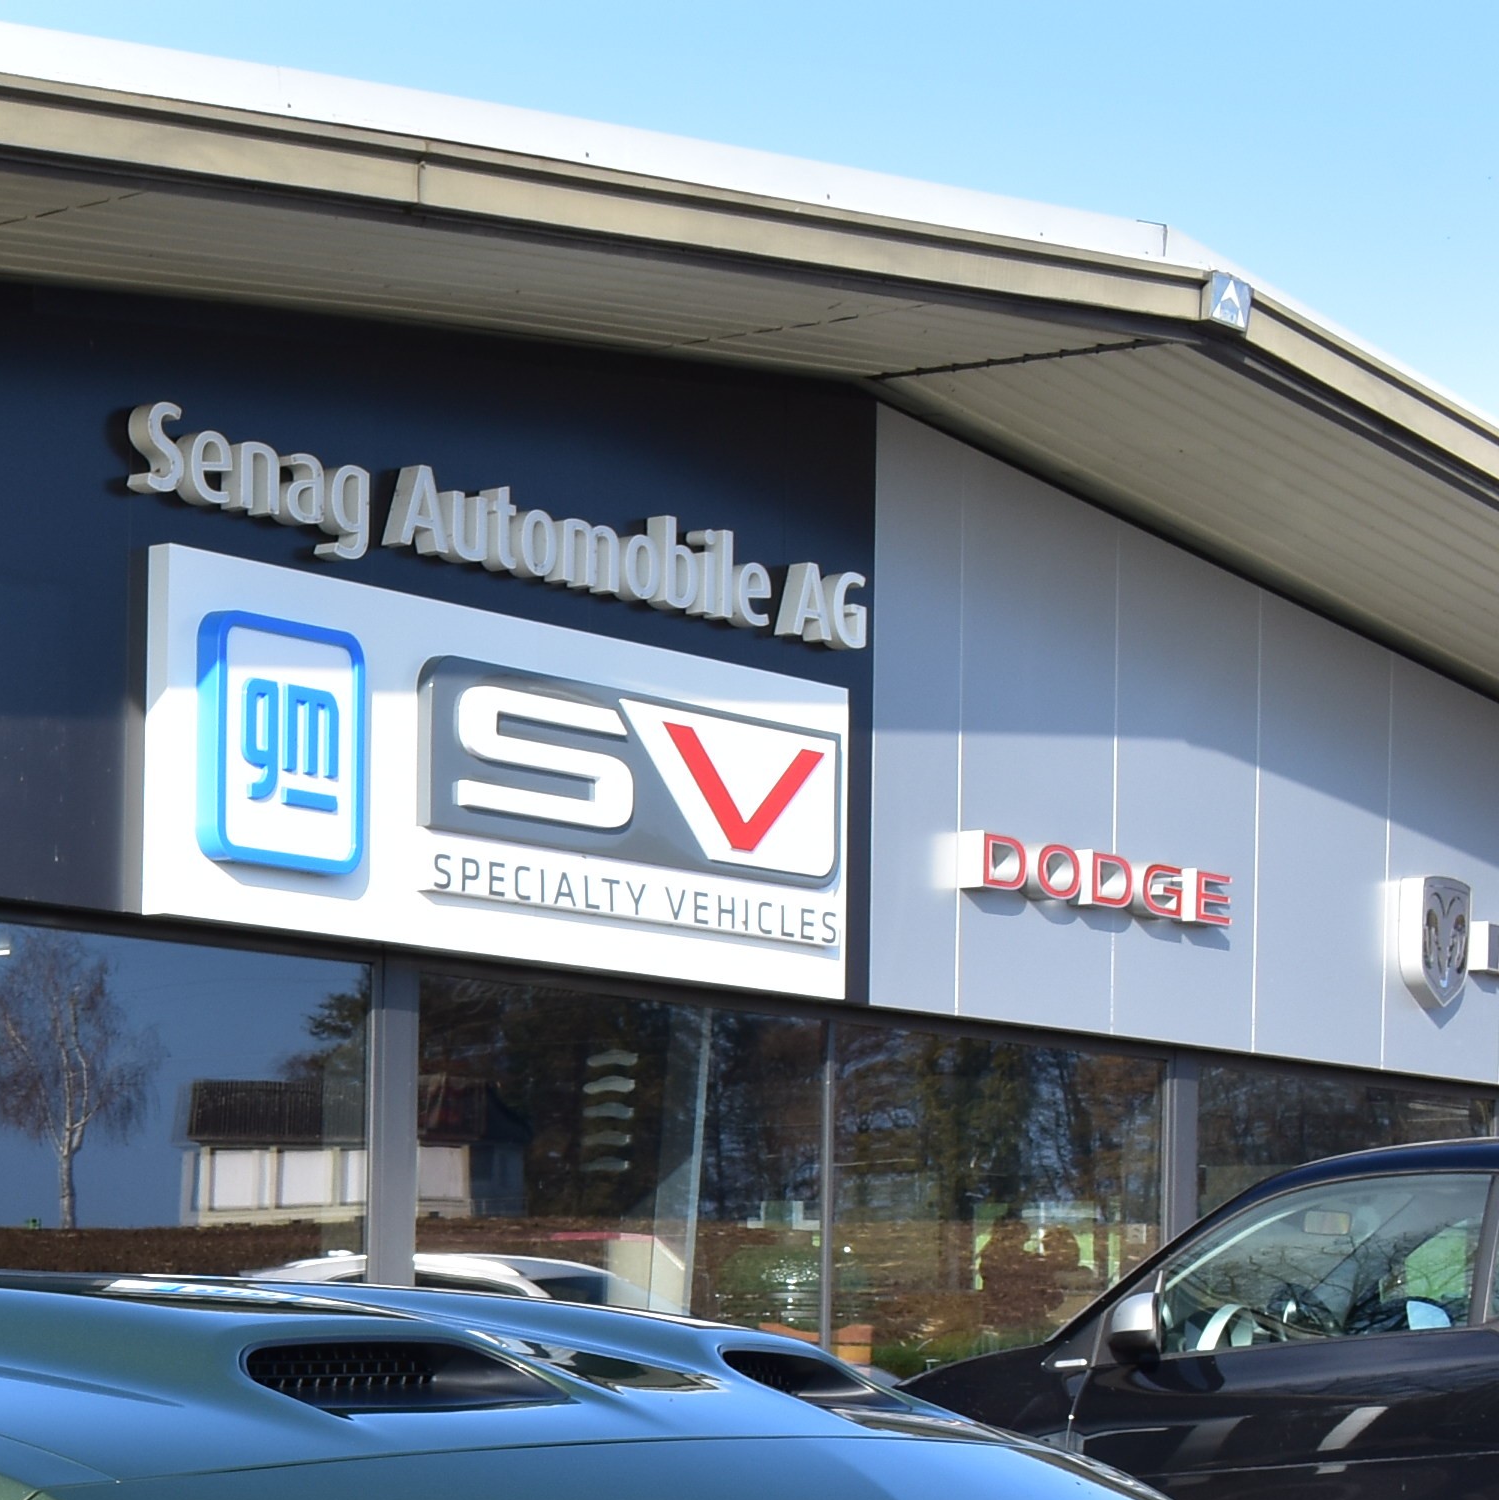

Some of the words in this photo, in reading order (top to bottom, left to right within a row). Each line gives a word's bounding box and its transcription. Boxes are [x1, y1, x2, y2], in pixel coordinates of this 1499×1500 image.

[127, 401, 371, 561] Senag
[382, 464, 772, 628] Automobile
[774, 562, 868, 650] AG
[241, 676, 340, 806] gm
[456, 684, 831, 858] SV
[432, 852, 648, 917] SPECIALTY
[664, 885, 839, 946] VEHICLES
[977, 831, 1233, 927] DODGE
